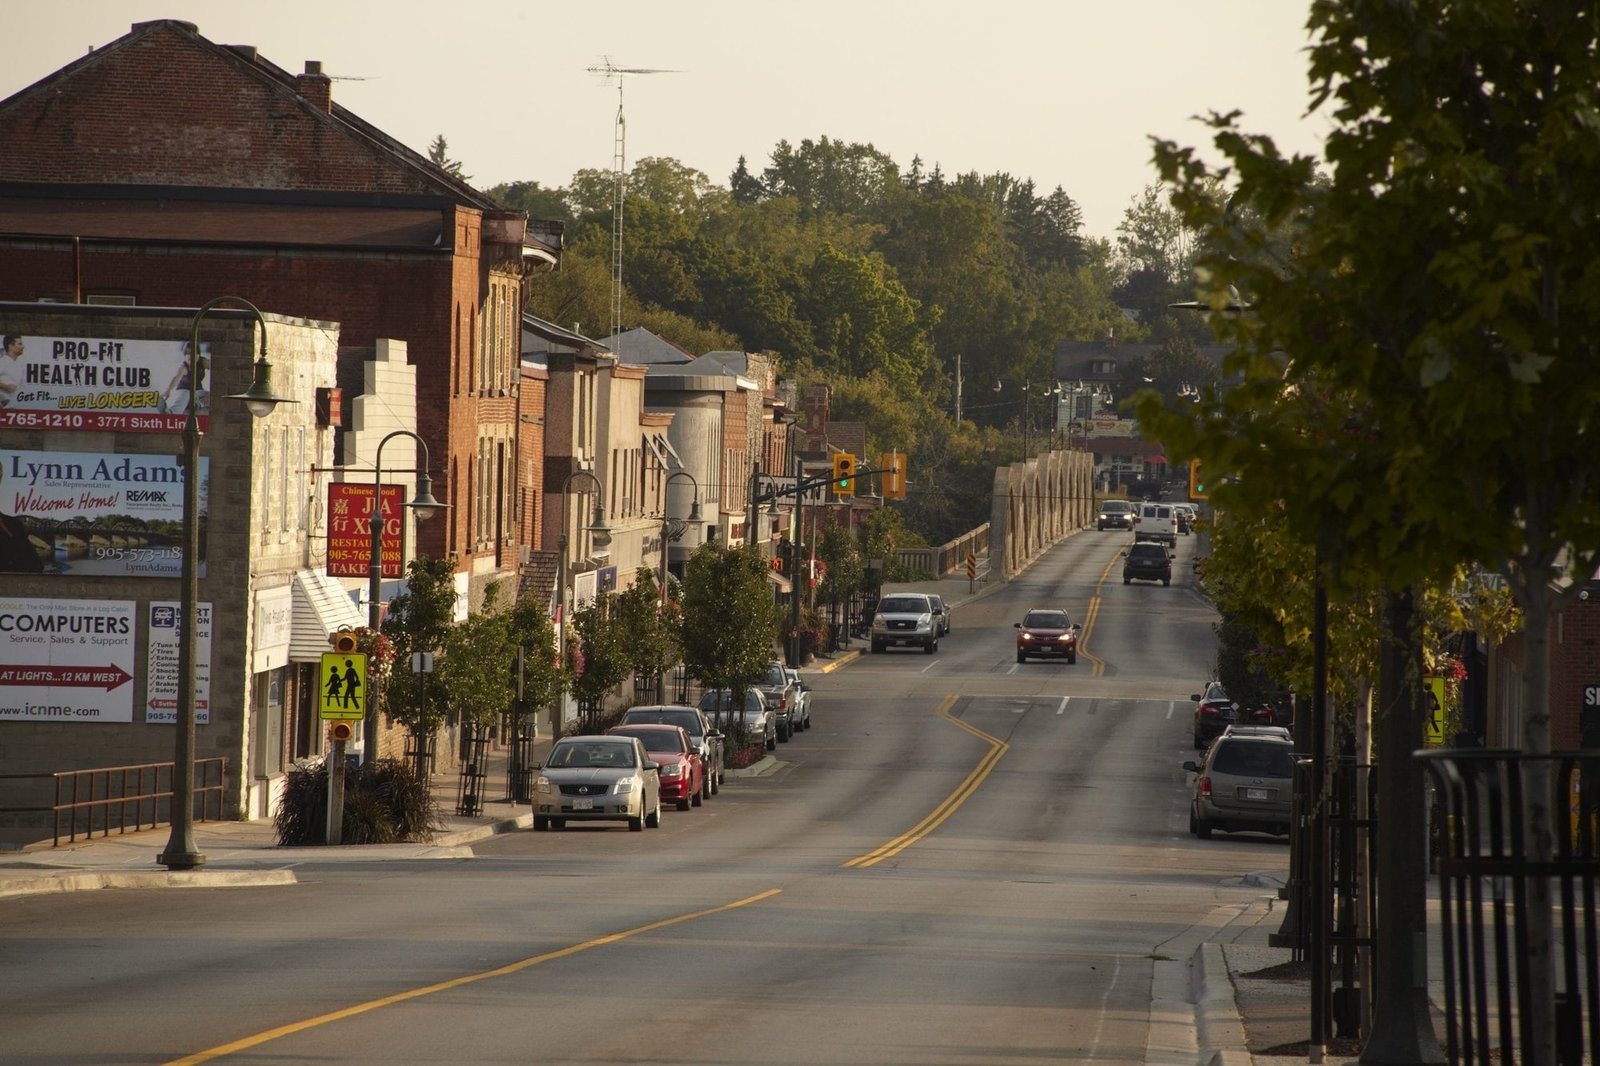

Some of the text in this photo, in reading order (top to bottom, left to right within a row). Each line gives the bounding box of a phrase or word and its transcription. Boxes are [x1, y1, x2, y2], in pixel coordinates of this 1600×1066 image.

[26, 363, 150, 388] HEALTH CLUB
[16, 392, 35, 402] Get
[58, 396, 86, 408] LIVE
[87, 391, 159, 408] LONGER!
[98, 416, 126, 428] 3771
[130, 418, 162, 429] Sixth
[10, 456, 83, 486] Lynn
[62, 481, 110, 490] Representative
[342, 486, 396, 496] Chinese ood
[14, 488, 167, 514] Welcome Home! RE/MAX
[331, 538, 402, 548] RESTAUANT
[330, 562, 368, 574] TAKE
[0, 614, 129, 634] COMPUTERS
[10, 635, 46, 644] Service,
[50, 636, 74, 644] Sales
[91, 636, 128, 646] Support
[1, 672, 14, 680] AT
[74, 673, 90, 682] KM
[93, 673, 122, 682] WEST
